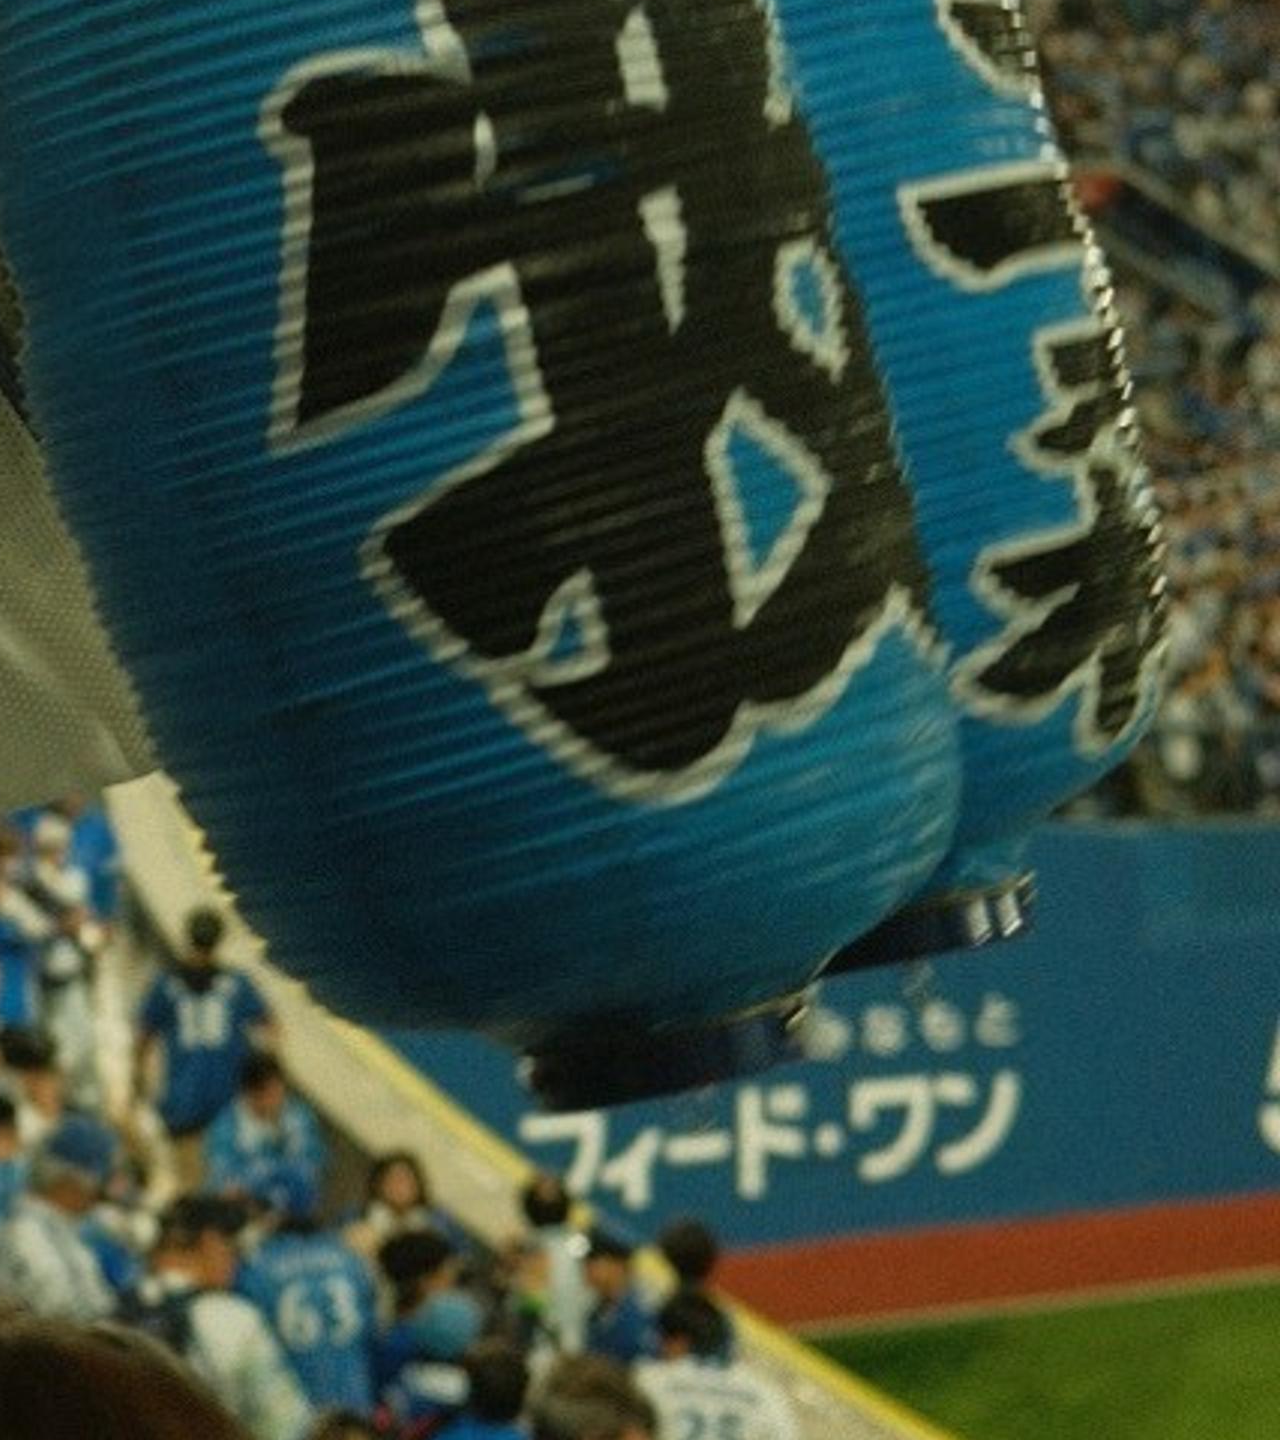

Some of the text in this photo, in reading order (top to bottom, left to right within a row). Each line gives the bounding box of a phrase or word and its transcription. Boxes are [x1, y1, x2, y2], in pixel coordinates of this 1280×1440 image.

[518, 1070, 1023, 1208] フィード・ワン
